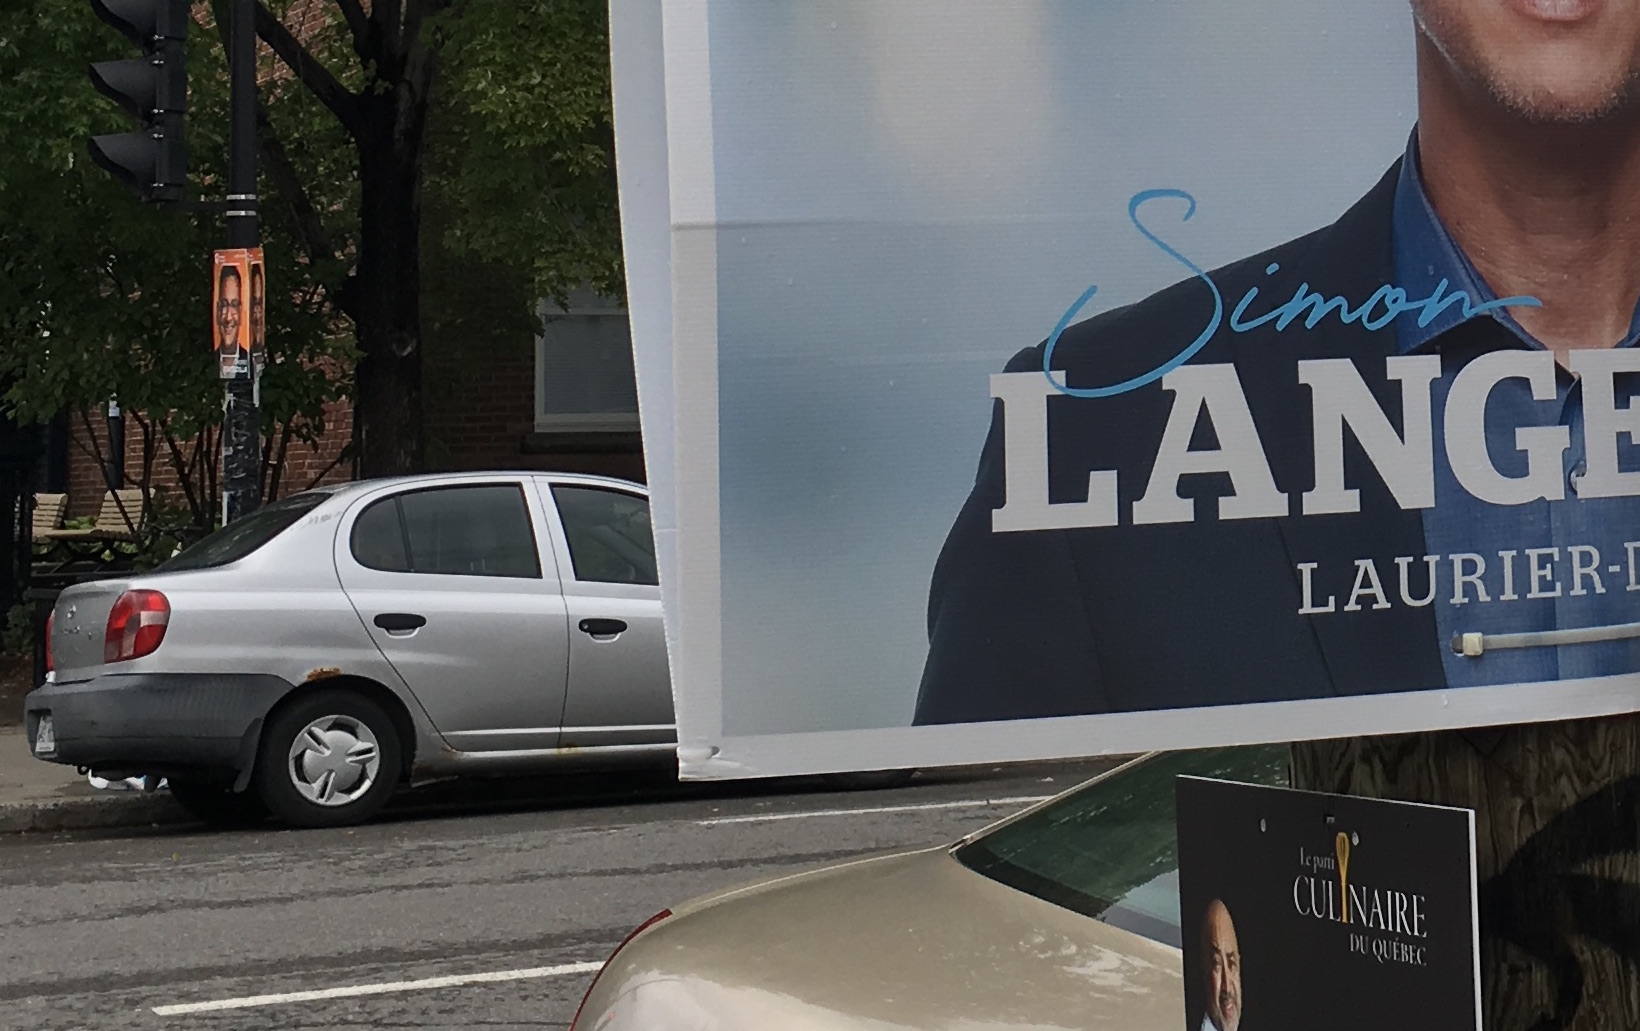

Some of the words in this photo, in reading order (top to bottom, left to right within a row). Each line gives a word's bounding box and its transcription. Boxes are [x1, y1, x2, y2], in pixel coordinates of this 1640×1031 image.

[1043, 189, 1542, 398] Simon
[1300, 846, 1311, 866] Le
[1313, 853, 1335, 874] parti
[1293, 874, 1427, 938] CULINAIRE
[1350, 933, 1369, 955] DU
[1372, 937, 1427, 967] QUÉBEC
